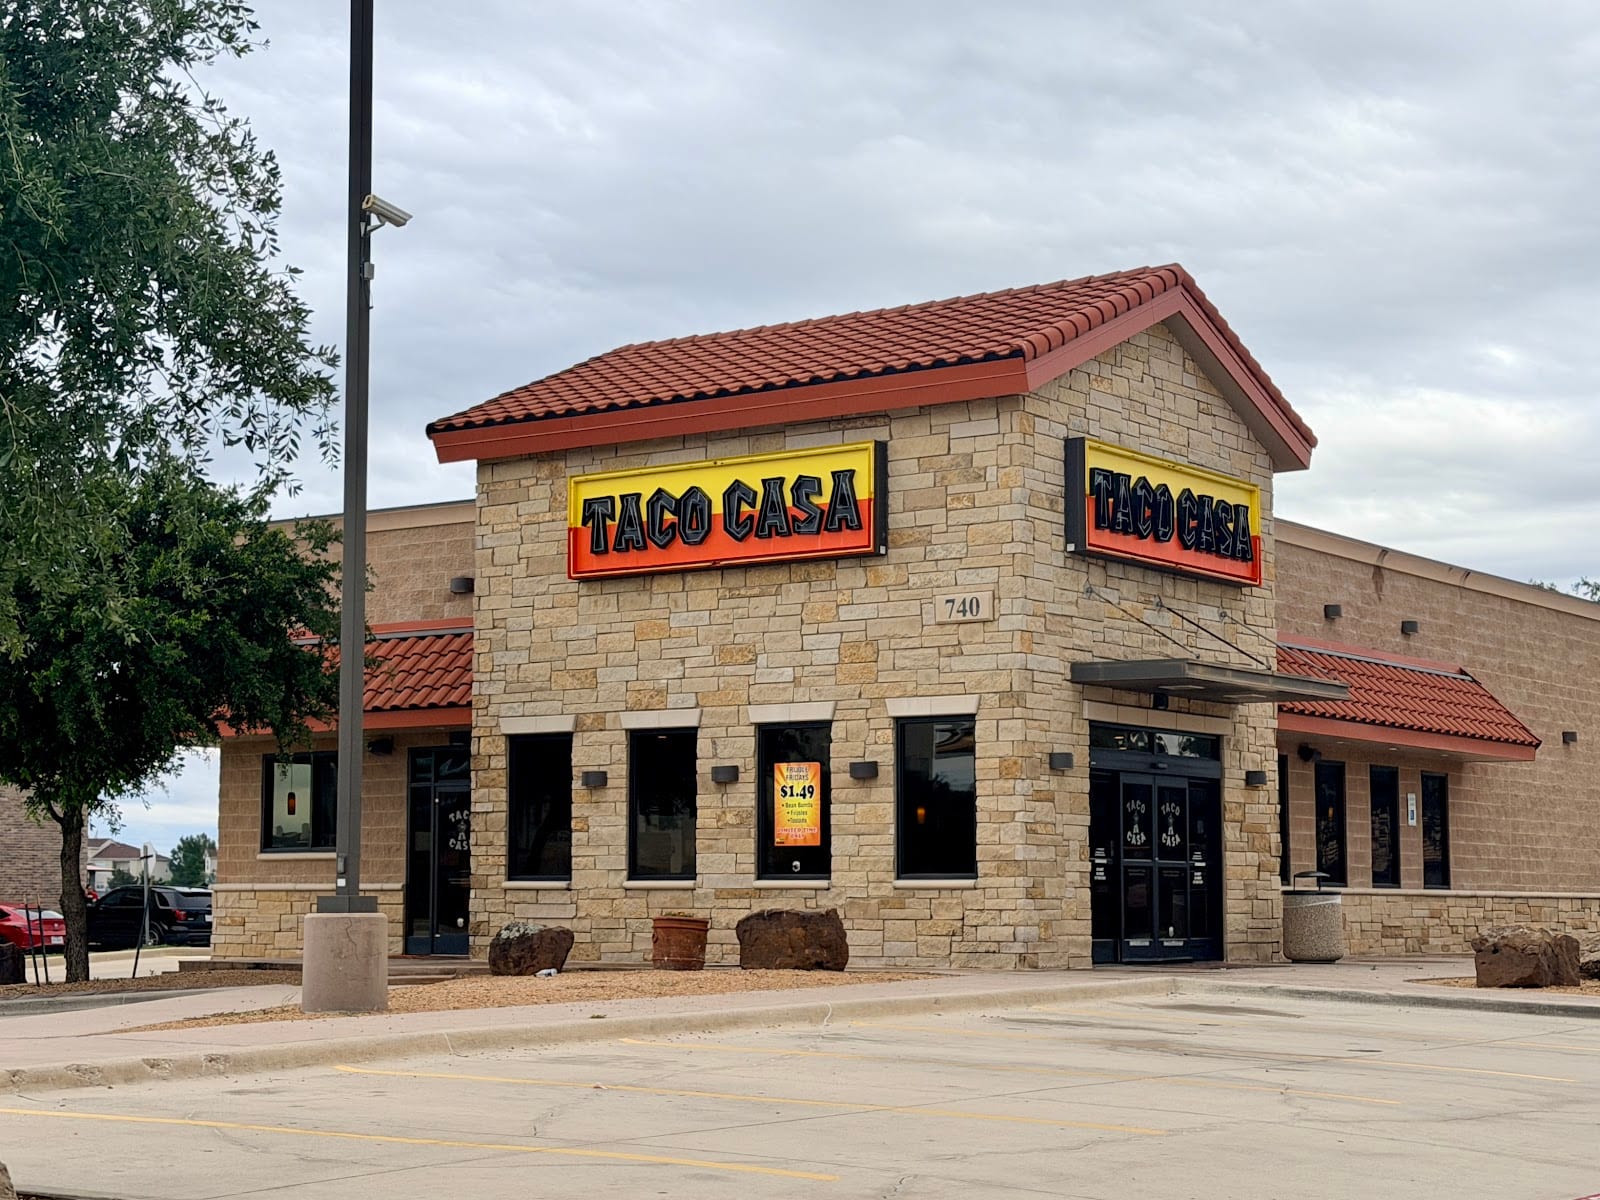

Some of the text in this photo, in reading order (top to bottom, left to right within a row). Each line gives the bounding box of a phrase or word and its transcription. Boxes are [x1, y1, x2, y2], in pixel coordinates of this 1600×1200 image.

[581, 469, 863, 555] TACO CASA
[1090, 467, 1254, 562] TACO CASA
[944, 596, 980, 619] 740
[780, 785, 814, 800] $1.49
[1126, 799, 1146, 814] TACO
[1161, 802, 1180, 816] TACO
[448, 809, 471, 823] TAC
[448, 838, 471, 850] CAS
[1126, 830, 1146, 846] CASA
[1161, 833, 1180, 847] CASA
